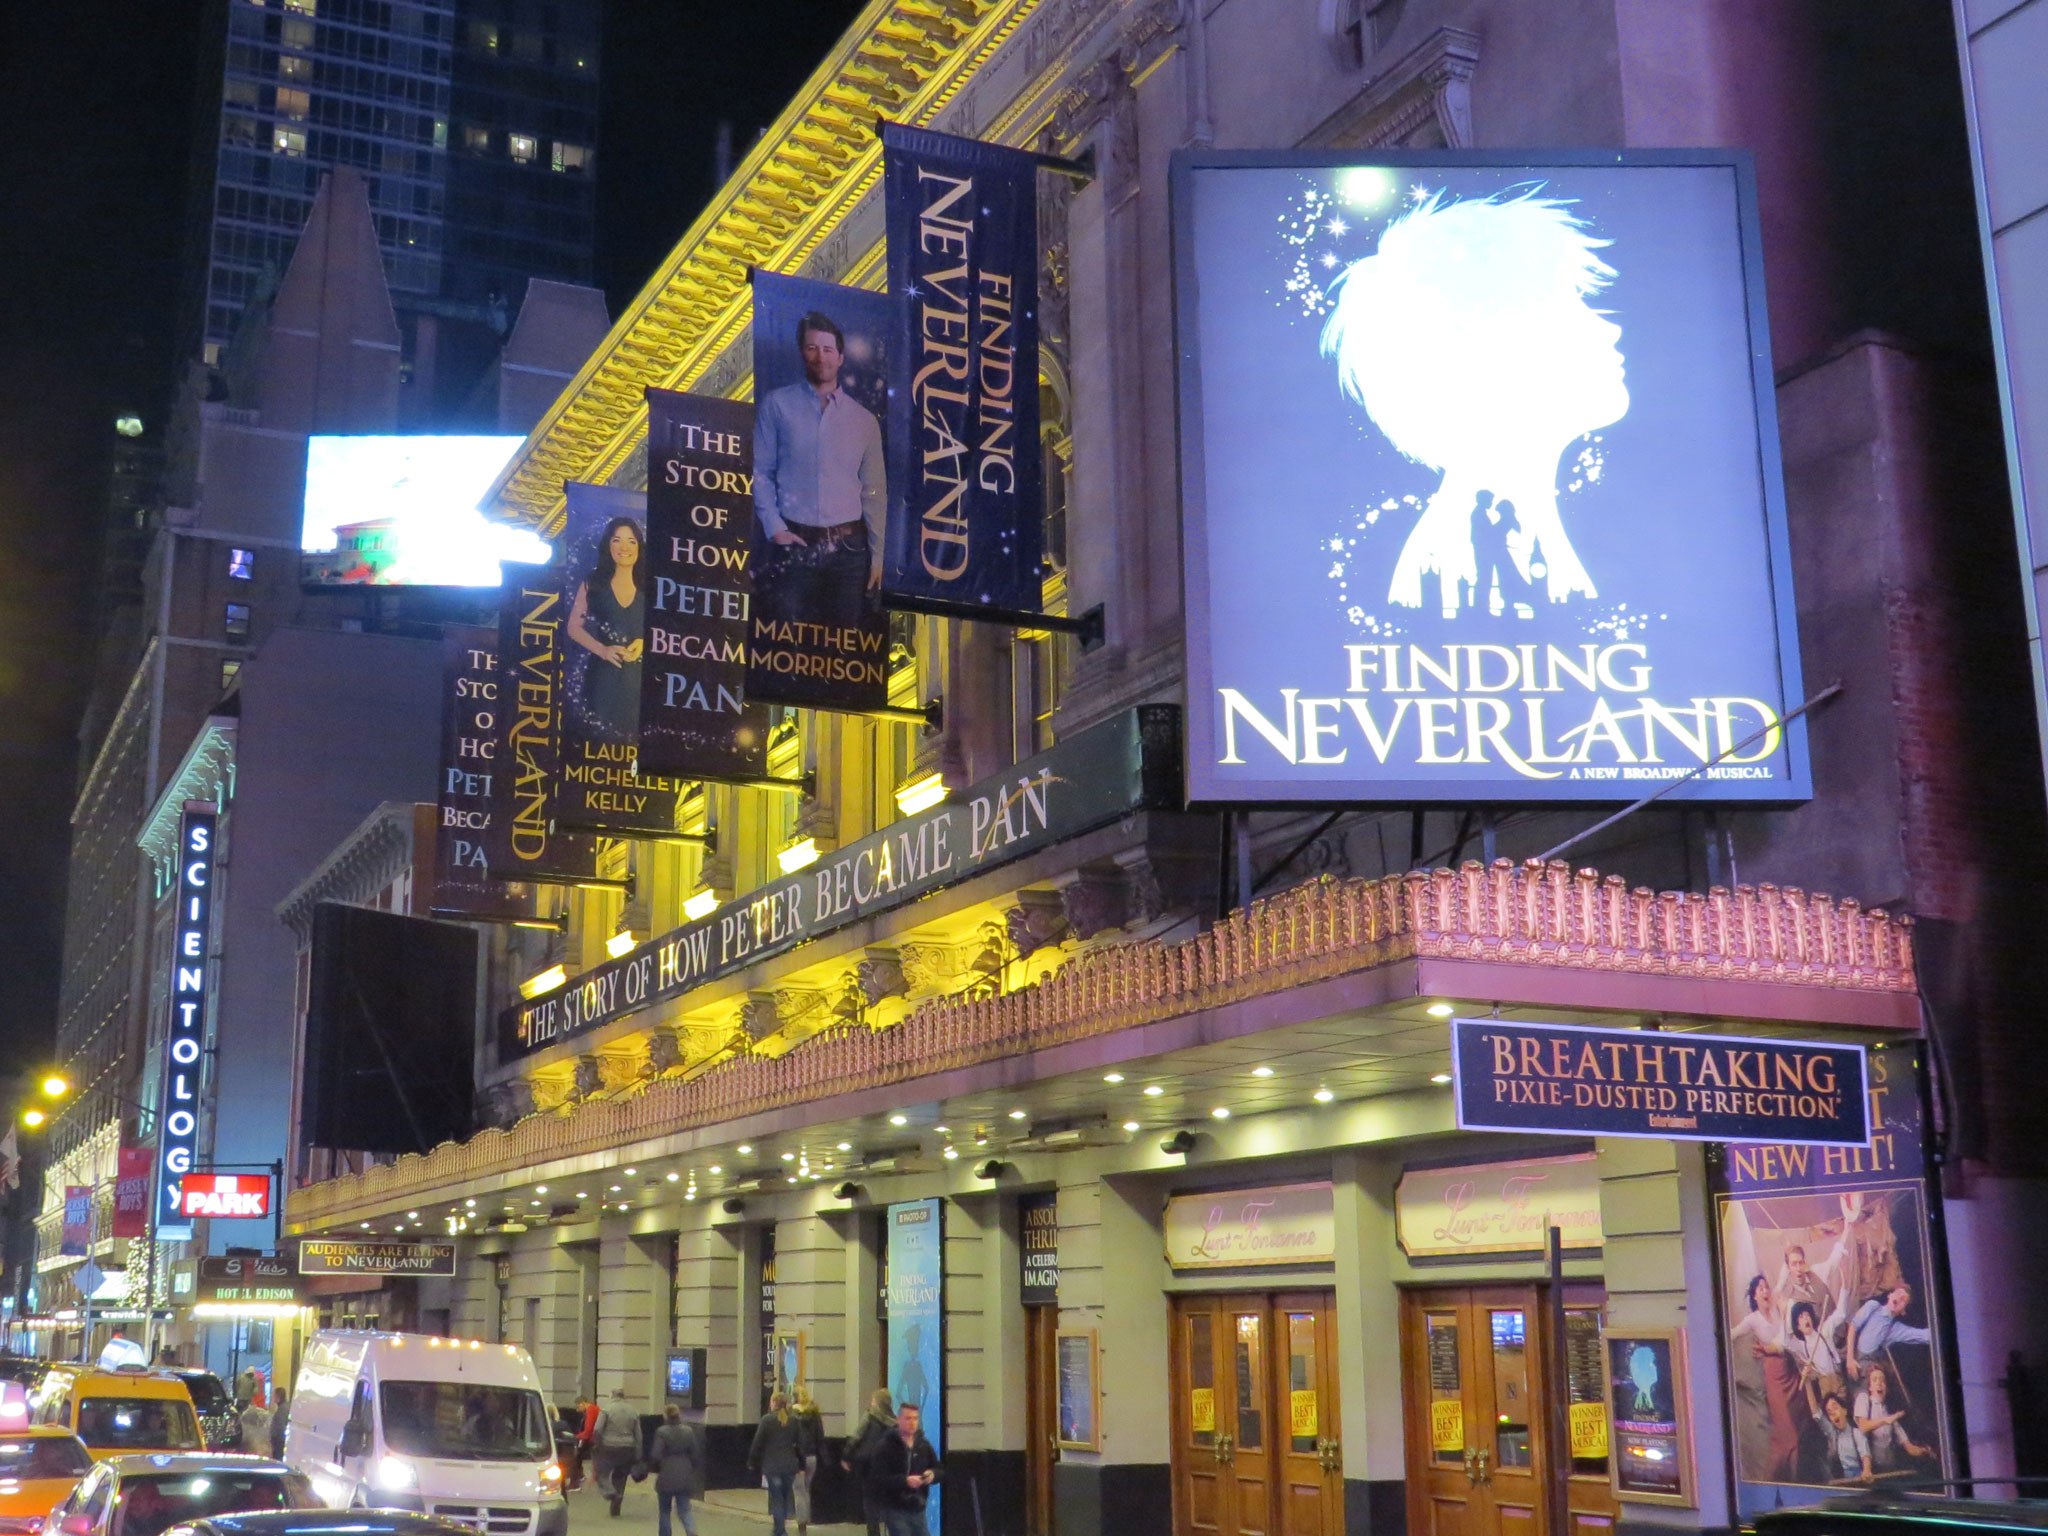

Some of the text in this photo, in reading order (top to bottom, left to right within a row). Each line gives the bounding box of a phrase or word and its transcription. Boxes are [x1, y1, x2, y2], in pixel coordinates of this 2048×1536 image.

[912, 165, 974, 582] NEVERLAND
[978, 268, 1015, 496] FINDING
[679, 422, 741, 456] THE
[665, 459, 754, 496] STORY
[690, 505, 728, 530] OF
[670, 536, 750, 571] HOW
[651, 626, 747, 665] BECAM
[755, 617, 884, 654] MATTHEW
[468, 649, 498, 671] TH
[749, 640, 885, 684] MORRISON
[1343, 643, 1654, 693] FINDING
[456, 677, 498, 700] STO
[663, 672, 743, 716] PAN
[474, 711, 494, 729] O
[508, 587, 560, 860] NEVERLAND
[1217, 687, 1783, 780] NEVERLAND
[584, 741, 638, 763] LAUR
[446, 767, 493, 798] PET
[565, 763, 669, 792] MICHELLE
[1569, 767, 1581, 779] A
[1584, 767, 1620, 779] NEW
[1707, 766, 1773, 780] MUSICAL
[585, 790, 648, 813] KELLY
[442, 806, 491, 830] BECA
[452, 839, 489, 868] PA
[523, 767, 1060, 1048] THE STORY OF HOW PETER BECAME PAN
[167, 826, 208, 1211] SCIENTOLOGY
[1494, 1078, 1678, 1112] PIXIE-DUSTED
[1734, 1133, 1896, 1183] NEW HIT!
[186, 1192, 263, 1215] PARK
[1026, 1207, 1057, 1227] ABSOL
[325, 1255, 343, 1267] TO
[379, 1245, 402, 1257] ARE
[407, 1245, 450, 1258] FLYING
[1024, 1269, 1060, 1287] IMAGIN
[255, 1287, 294, 1300] EDISON
[1294, 1403, 1315, 1418] BEST
[1432, 1403, 1461, 1414] WINNER
[1571, 1405, 1604, 1418] WINNER
[1436, 1416, 1460, 1431] BEST
[1575, 1420, 1603, 1436] BEST
